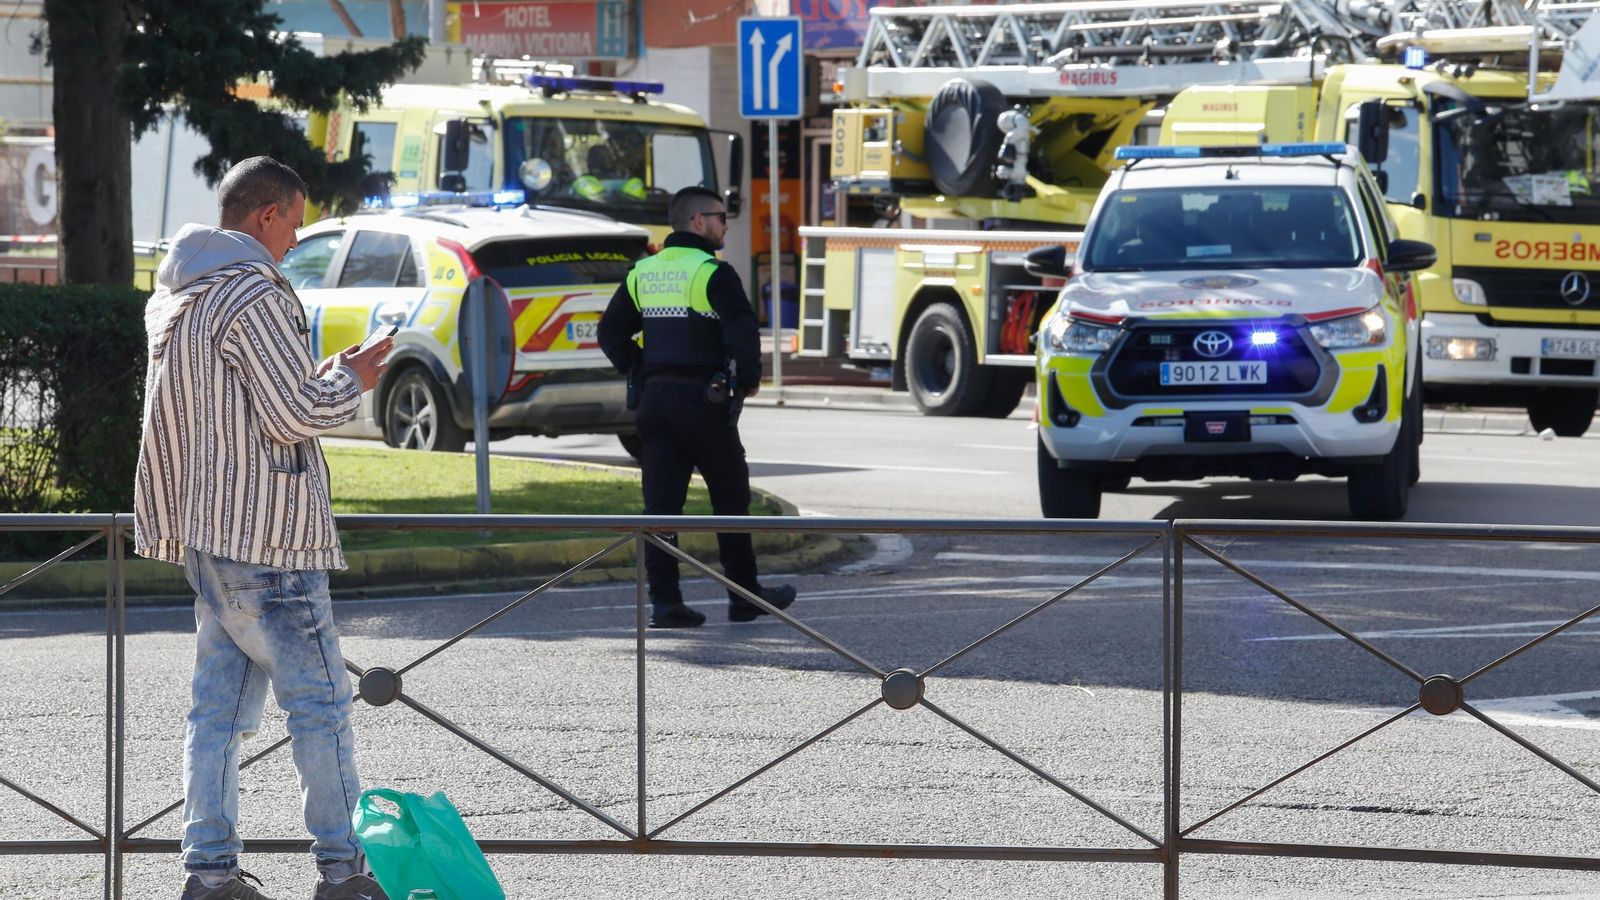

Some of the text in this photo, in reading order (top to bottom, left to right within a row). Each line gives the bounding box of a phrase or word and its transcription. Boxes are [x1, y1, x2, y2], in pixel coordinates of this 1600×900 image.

[505, 7, 552, 27] HOTEL
[465, 32, 593, 53] MARINA VICTORIA
[1060, 71, 1118, 86] MAGIRUS
[527, 252, 630, 265] POLICIA LOCAL
[639, 271, 689, 282] POLICIA
[642, 283, 682, 295] LOCAL
[1173, 364, 1260, 382] 9012 LWK
